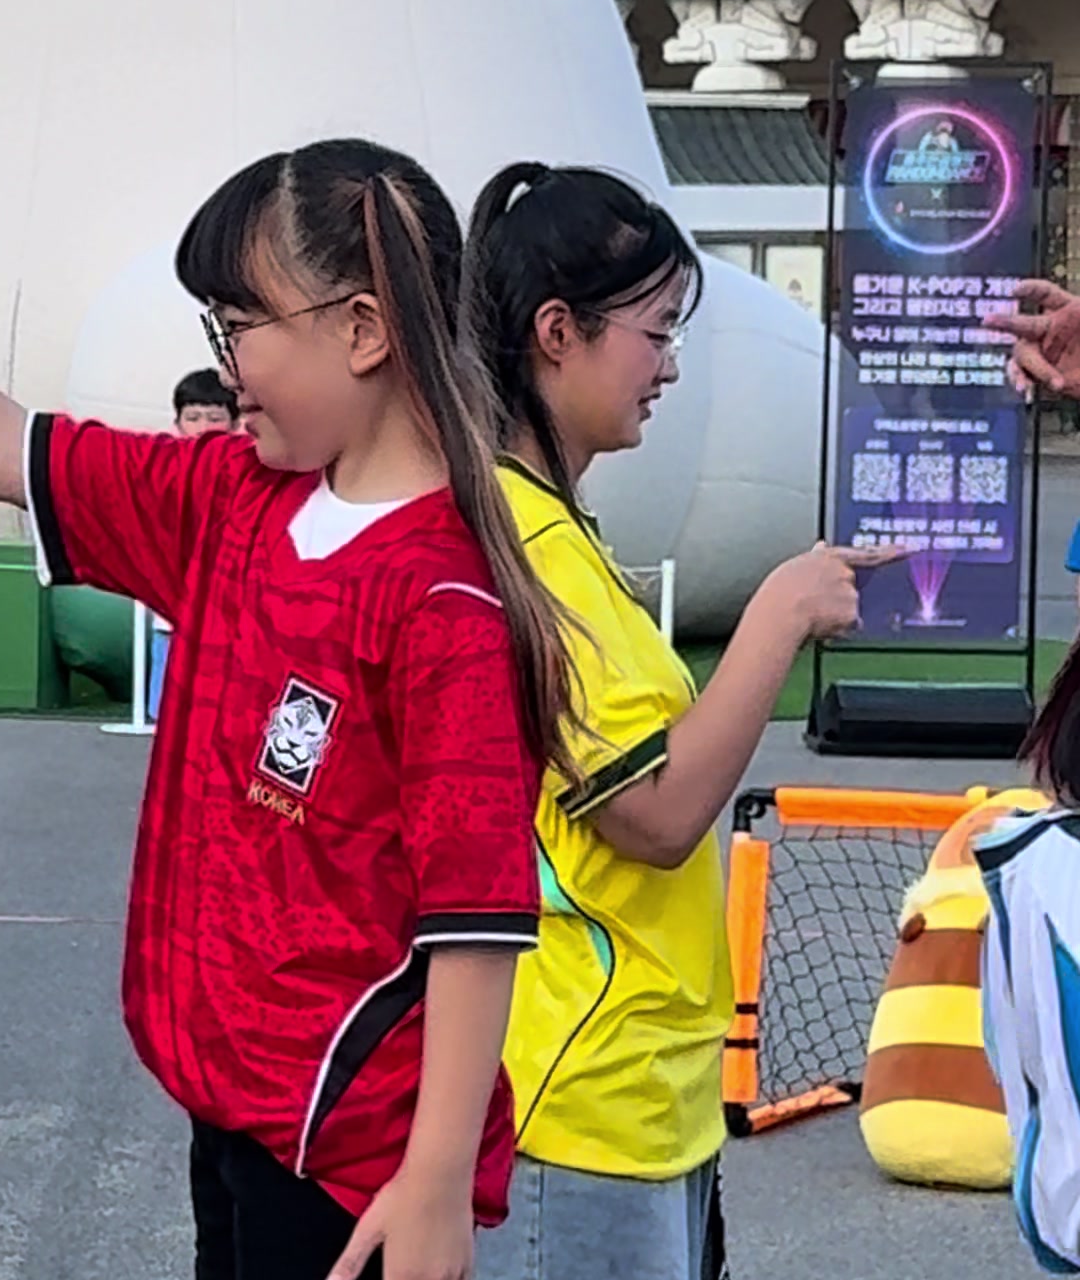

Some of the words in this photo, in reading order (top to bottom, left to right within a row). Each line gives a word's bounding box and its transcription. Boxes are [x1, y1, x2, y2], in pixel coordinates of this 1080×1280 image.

[853, 297, 902, 316] 그리고
[852, 325, 890, 342] 누구나
[247, 776, 305, 826] KOREA
